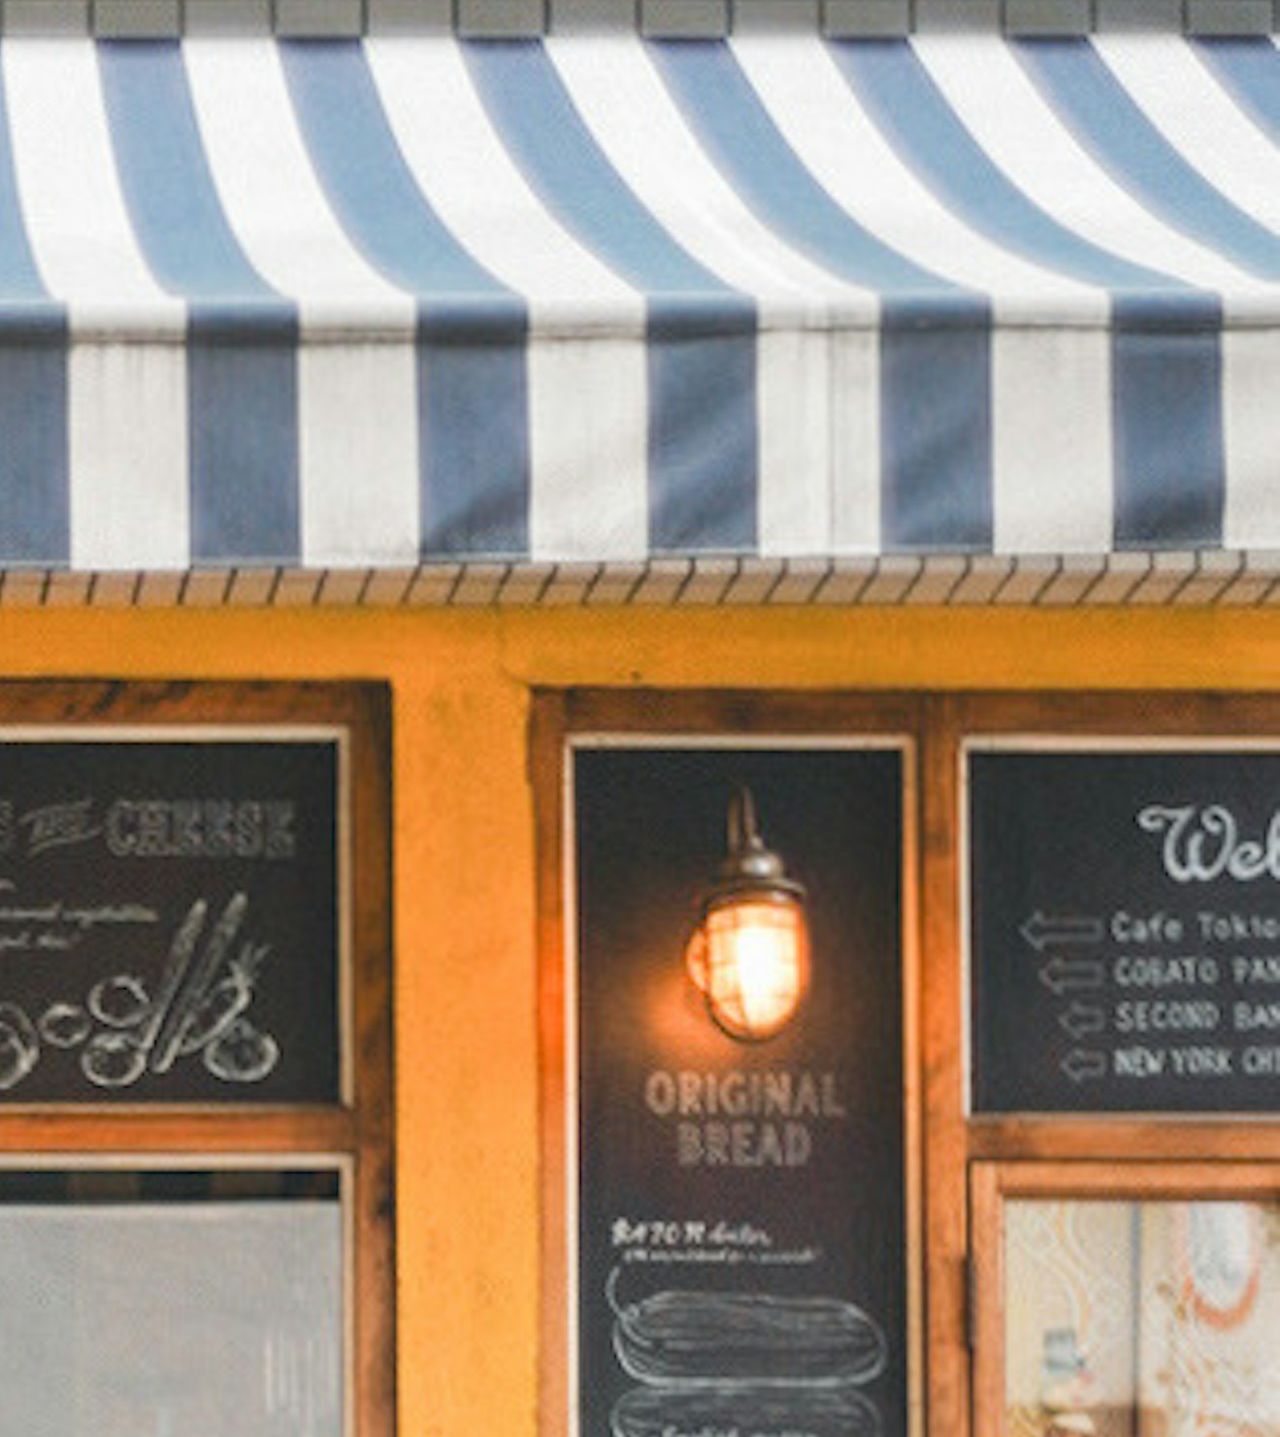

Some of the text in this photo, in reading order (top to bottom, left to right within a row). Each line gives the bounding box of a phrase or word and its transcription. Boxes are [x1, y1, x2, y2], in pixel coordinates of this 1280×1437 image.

[105, 797, 298, 858] CHEESE
[1110, 911, 1184, 943] Cafe
[1114, 1001, 1221, 1033] SECOND
[1113, 1047, 1166, 1078] NEW
[1169, 1046, 1233, 1076] YORK
[643, 1069, 846, 1117] ORIGINAL
[678, 1121, 813, 1165] BREAD
